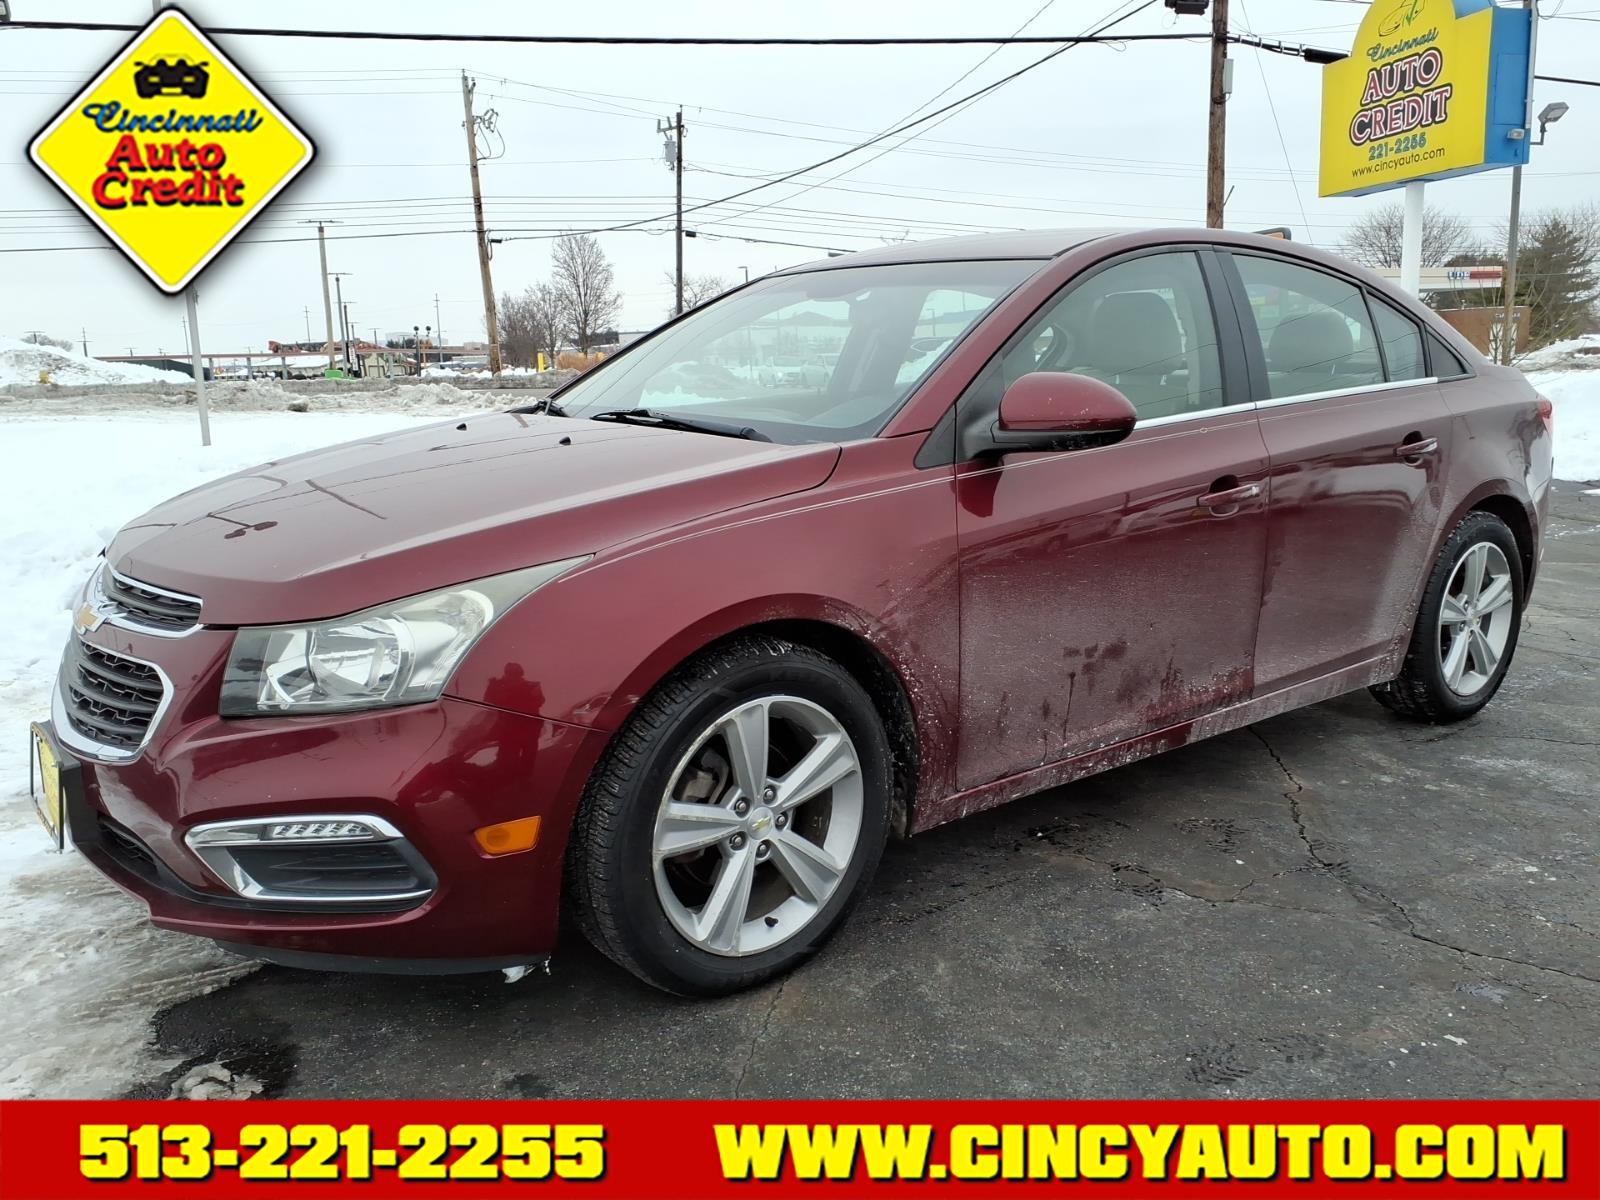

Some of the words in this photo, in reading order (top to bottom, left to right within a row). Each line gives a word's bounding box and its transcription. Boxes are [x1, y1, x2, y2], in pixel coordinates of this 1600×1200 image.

[1367, 27, 1439, 62] Cincinnati
[1361, 49, 1442, 104] AUTO
[1350, 85, 1452, 144] CREDIT
[1352, 147, 1445, 177] www.cincyauto.com
[1368, 132, 1427, 161] 221-2255
